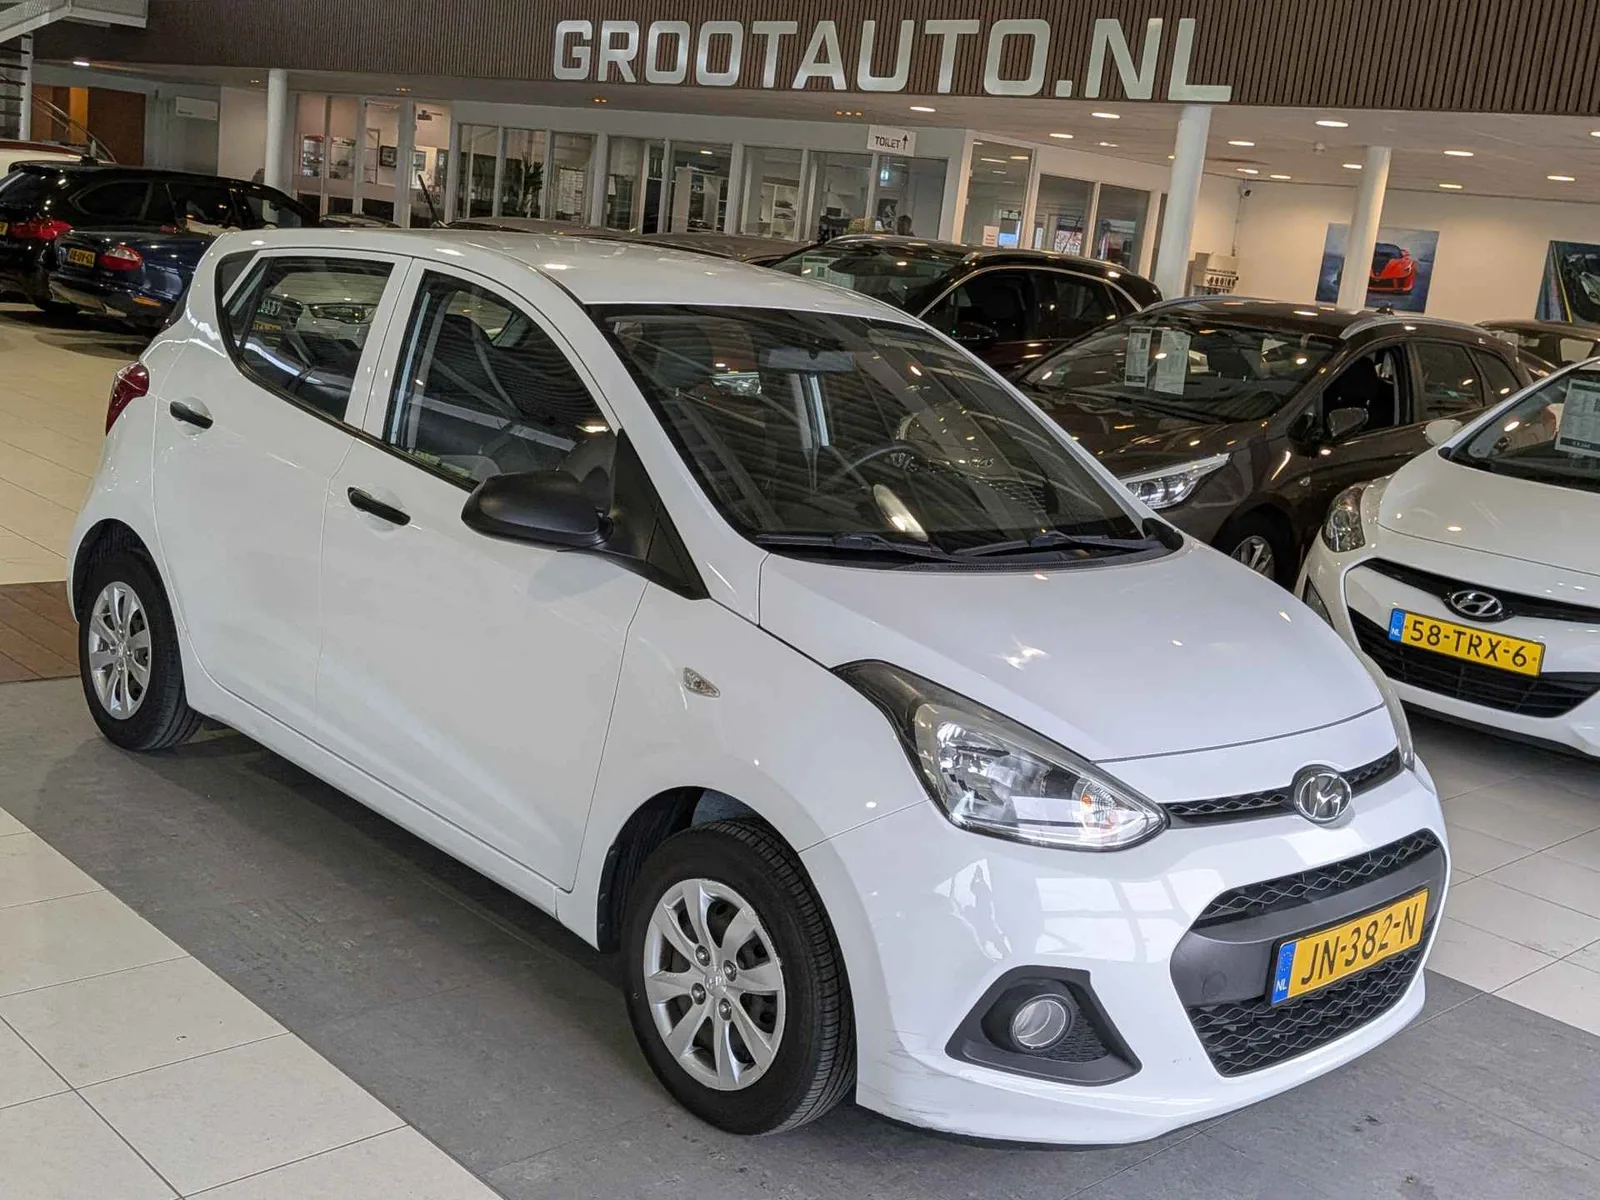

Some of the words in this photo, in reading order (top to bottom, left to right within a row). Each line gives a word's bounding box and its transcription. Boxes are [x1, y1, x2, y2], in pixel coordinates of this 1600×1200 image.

[553, 17, 1232, 103] GROOTAUTO.NL
[875, 136, 900, 148] TOILET
[1390, 627, 1401, 636] NL
[1410, 620, 1527, 667] 58-TRX-6
[1301, 903, 1418, 985] JN-382-N
[1275, 978, 1288, 992] NL
